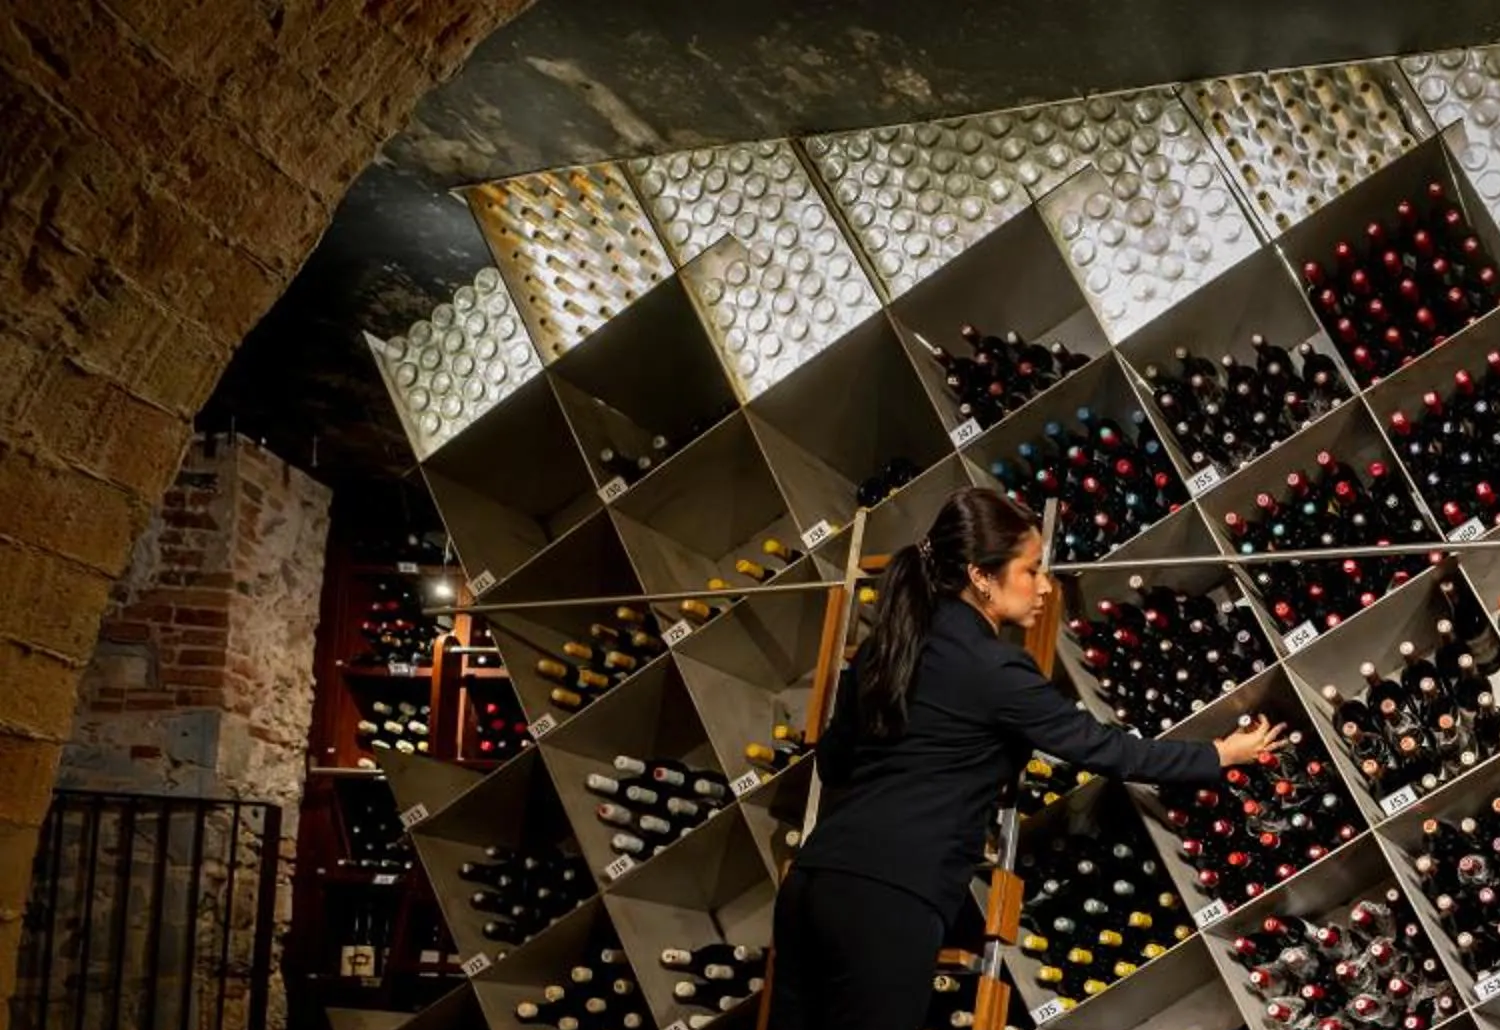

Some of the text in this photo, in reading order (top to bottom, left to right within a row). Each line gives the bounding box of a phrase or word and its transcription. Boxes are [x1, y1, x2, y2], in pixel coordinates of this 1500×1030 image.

[1195, 473, 1212, 487] J55
[1293, 630, 1309, 645] J54
[738, 777, 753, 790] J28
[1390, 794, 1409, 810] J53
[1203, 906, 1221, 921] J44
[1483, 979, 1500, 994] J52
[1039, 1004, 1057, 1019] J35
